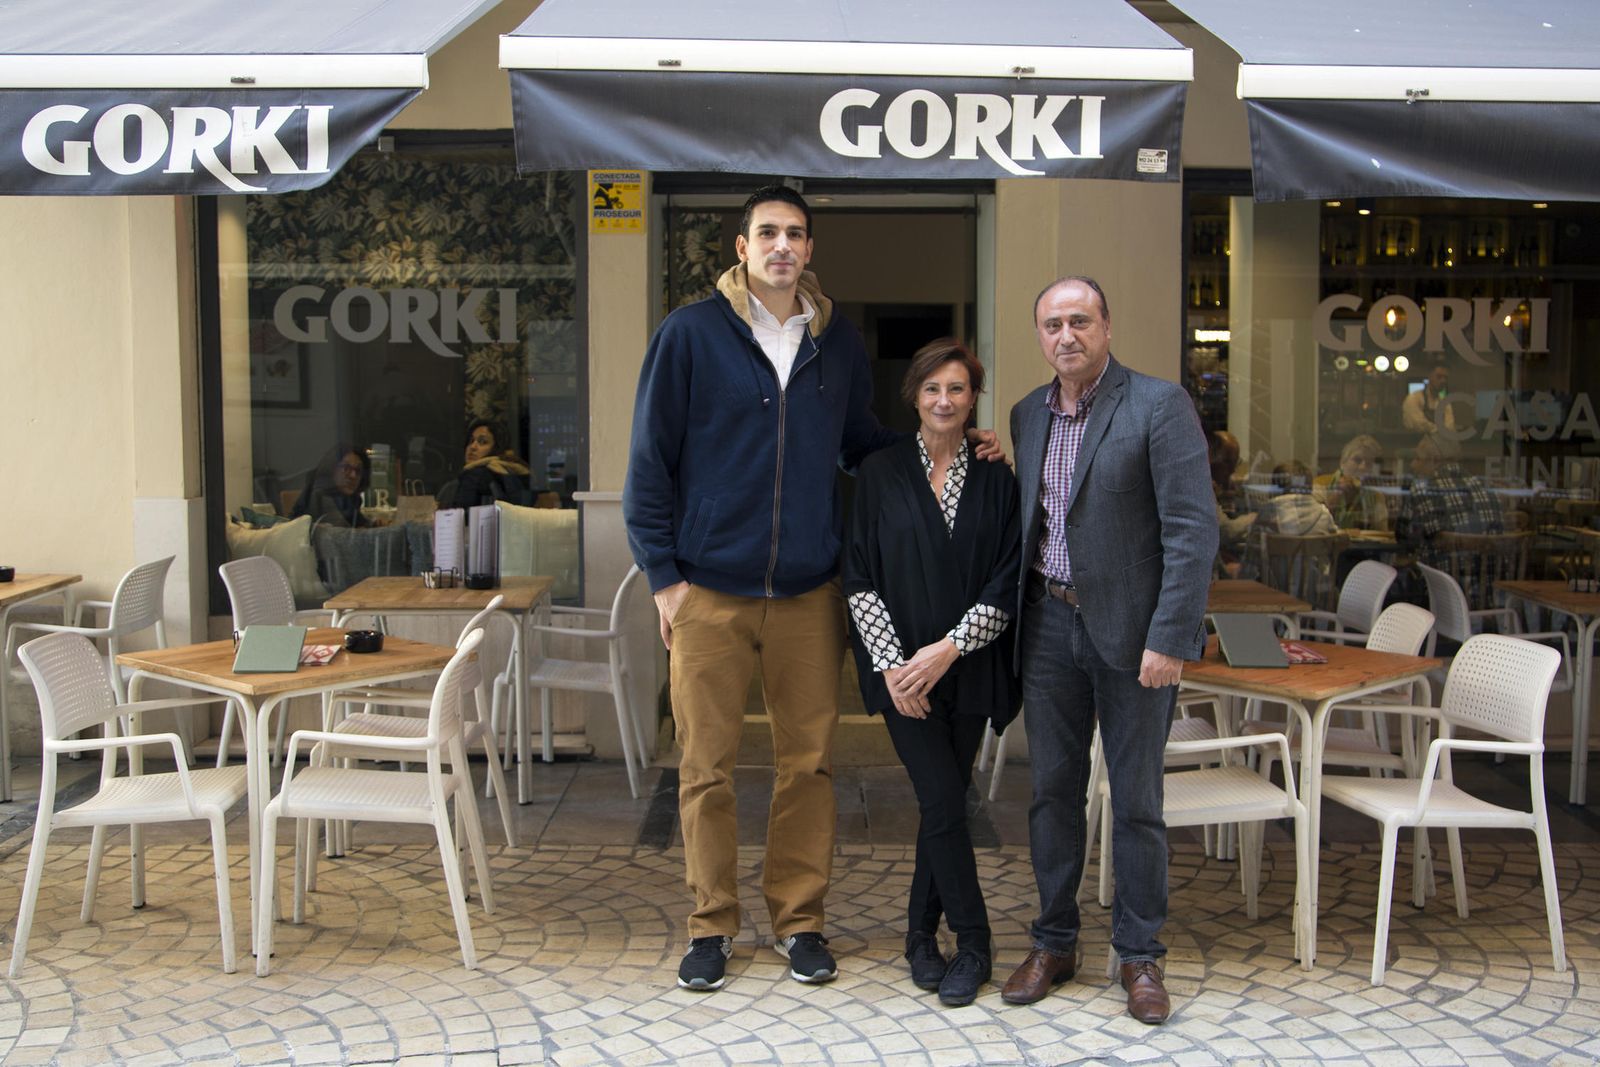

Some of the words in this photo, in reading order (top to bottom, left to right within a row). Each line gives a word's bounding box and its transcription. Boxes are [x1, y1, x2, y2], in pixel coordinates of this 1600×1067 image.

[22, 103, 333, 191] GORKI
[819, 88, 1105, 176] GORKI
[594, 210, 642, 218] PROSEGUR
[273, 284, 519, 358] GORKI
[1313, 293, 1551, 368] GORKI
[1434, 391, 1600, 442] CASA
[1485, 456, 1600, 490] FUND
